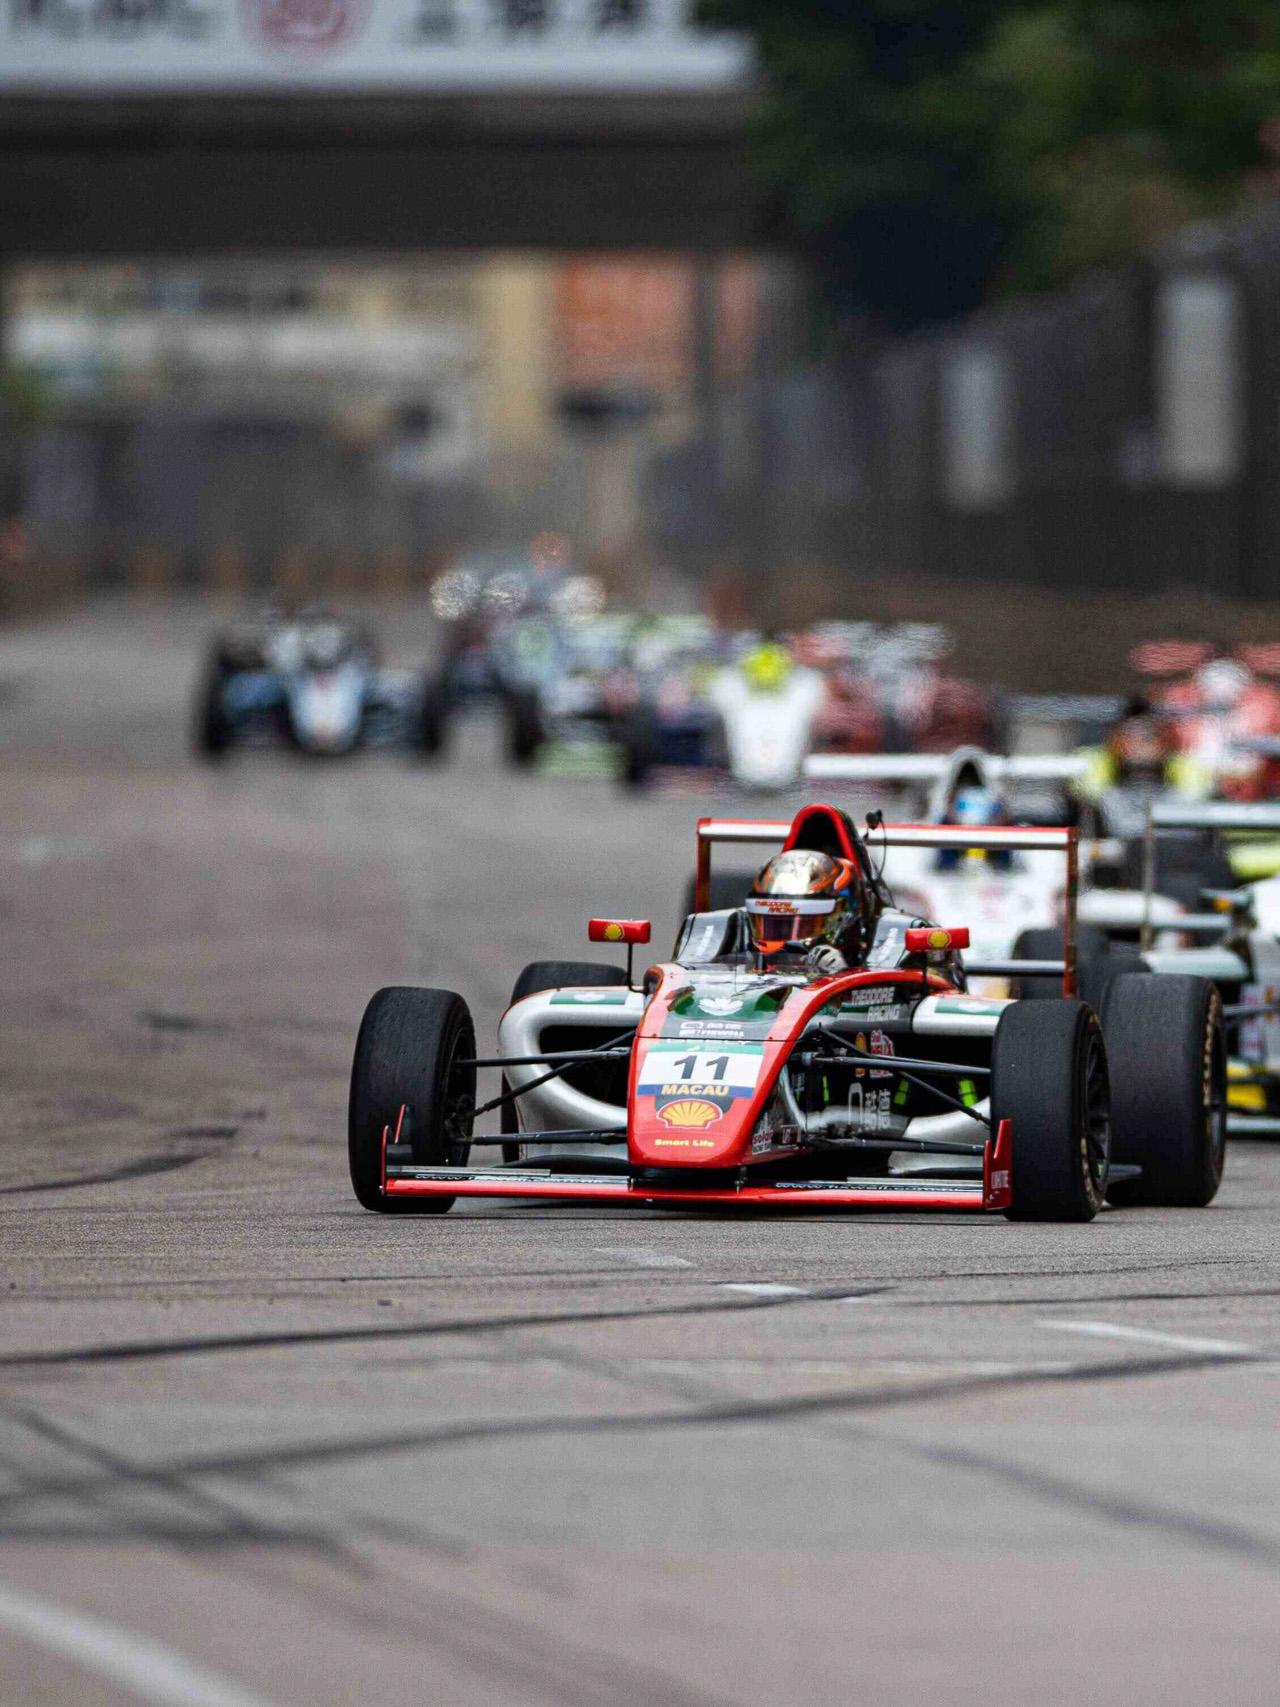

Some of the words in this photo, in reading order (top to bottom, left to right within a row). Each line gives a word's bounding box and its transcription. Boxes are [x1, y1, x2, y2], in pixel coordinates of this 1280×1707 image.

[673, 1055, 730, 1080] 11
[661, 1084, 729, 1096] MACAU
[654, 1139, 690, 1147] Smart
[692, 1139, 714, 1148] Life
